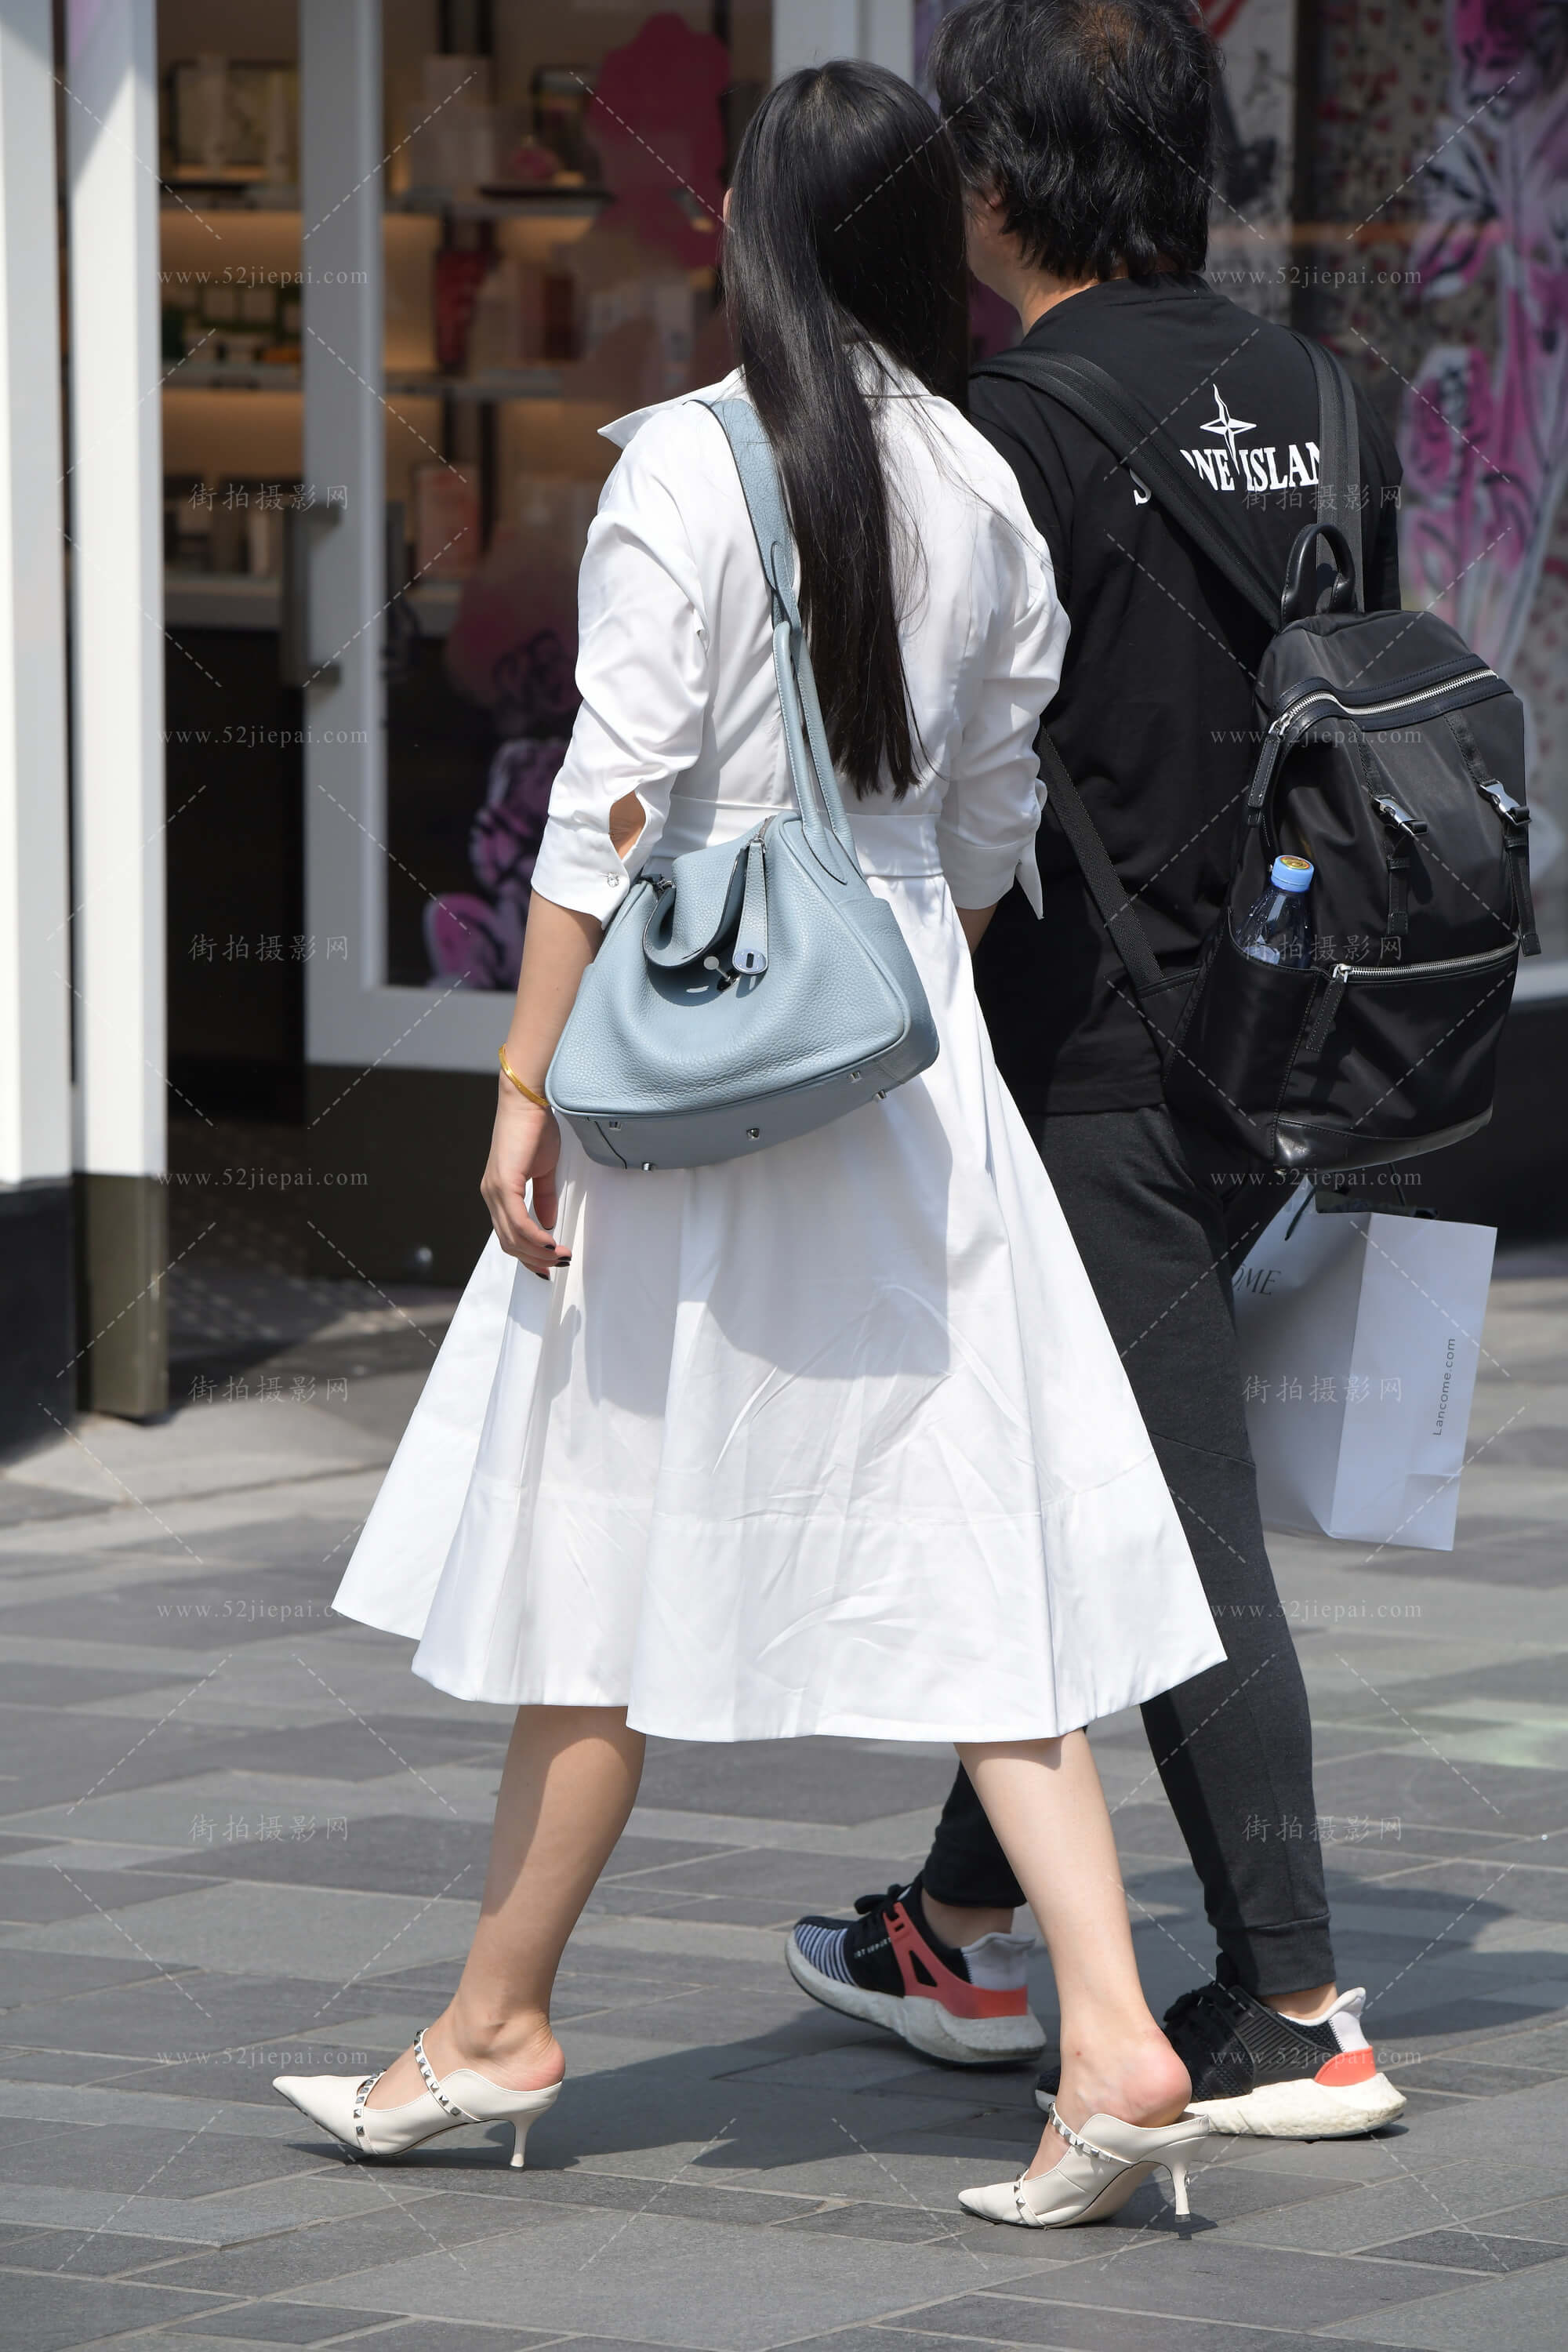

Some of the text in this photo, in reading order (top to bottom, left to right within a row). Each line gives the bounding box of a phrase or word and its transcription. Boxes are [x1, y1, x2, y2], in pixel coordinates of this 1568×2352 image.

[1129, 441, 1319, 506] SNE ISLAN
[1432, 1338, 1456, 1436] Lancome.com
